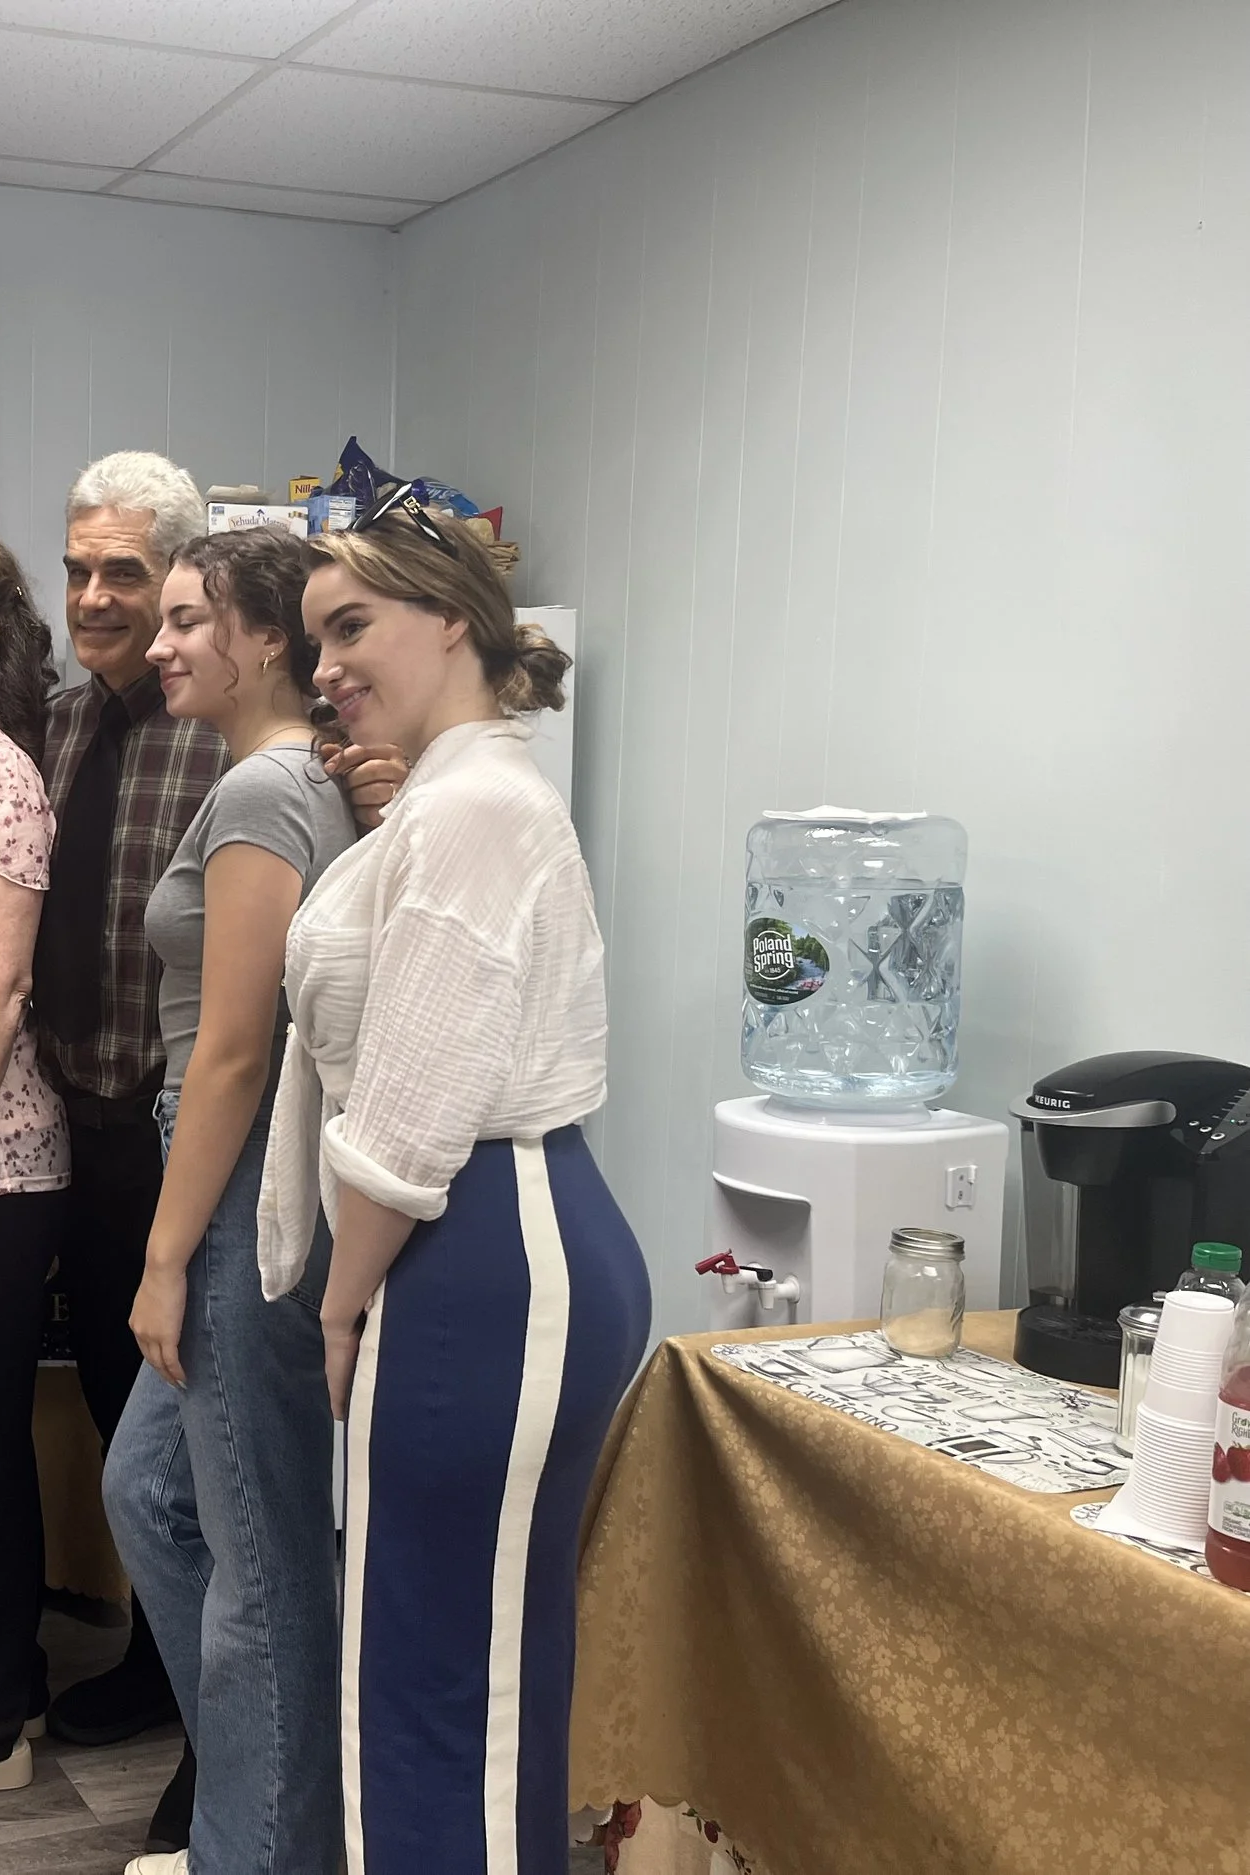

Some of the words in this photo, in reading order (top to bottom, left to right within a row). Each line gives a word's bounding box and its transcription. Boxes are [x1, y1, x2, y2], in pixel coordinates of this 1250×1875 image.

[295, 484, 315, 494] Nill
[230, 515, 259, 528] Yehuda
[752, 933, 793, 956] Poland
[1034, 1094, 1071, 1109] KEURIG
